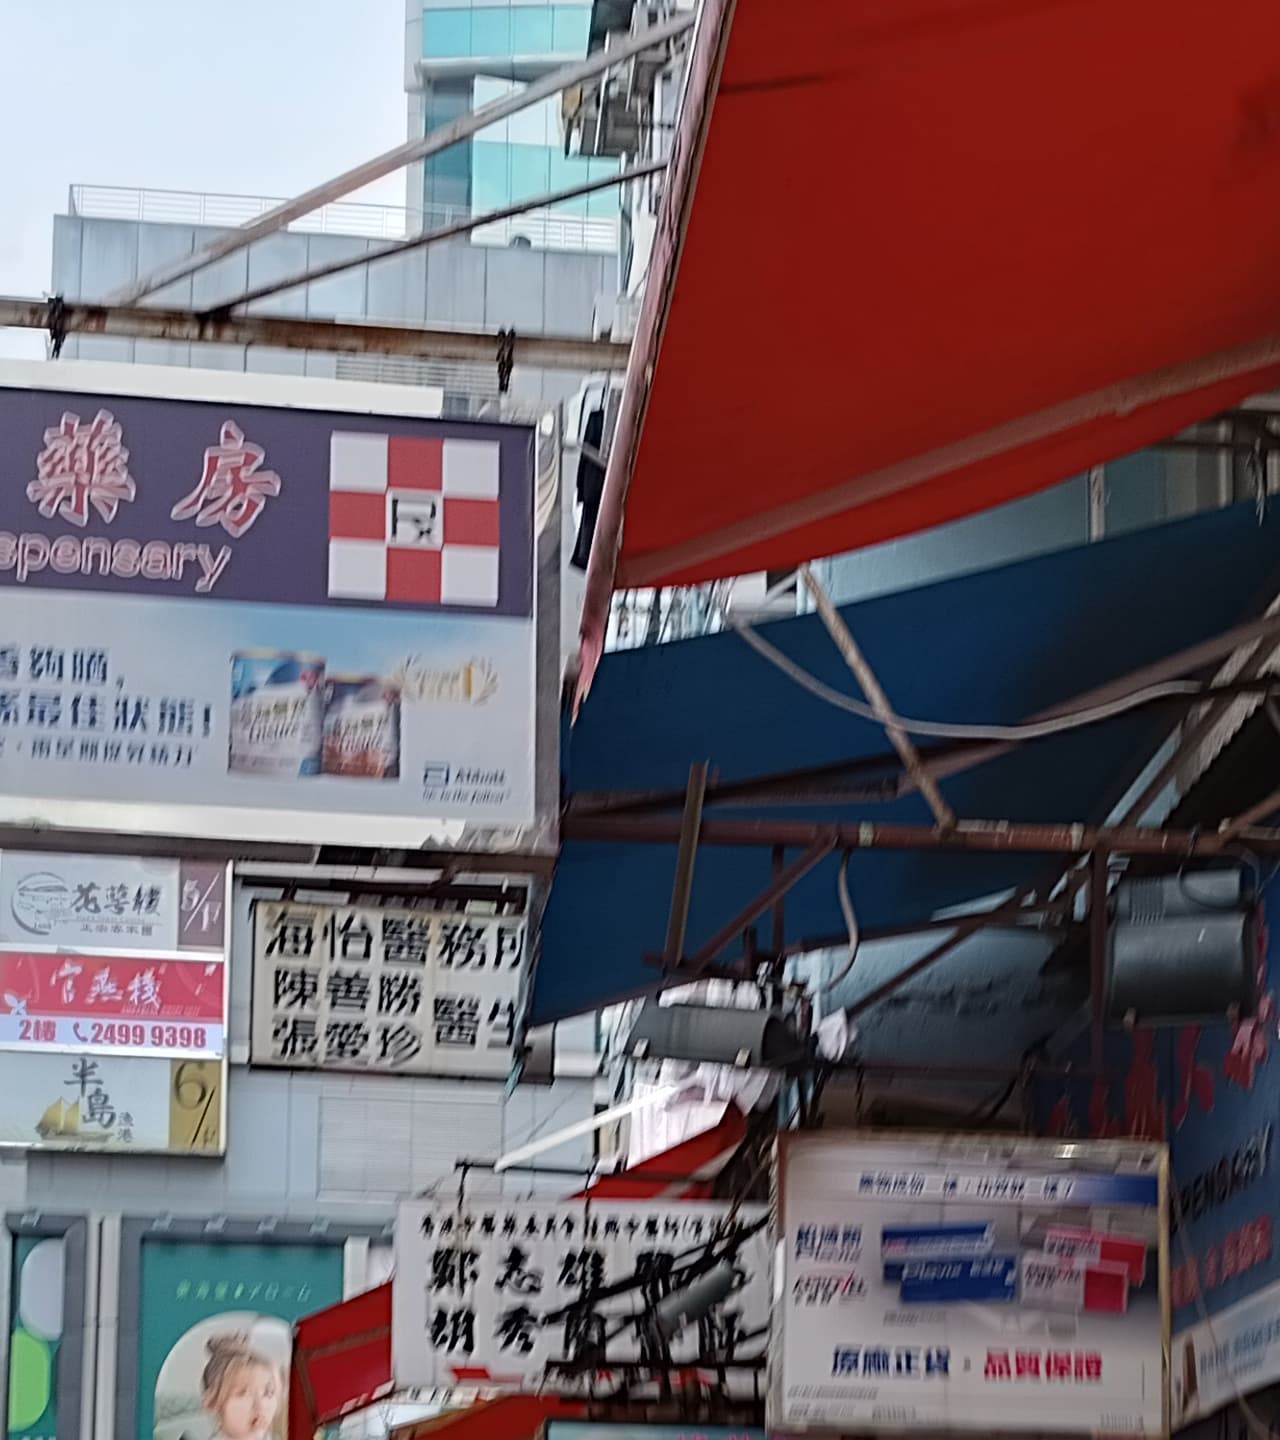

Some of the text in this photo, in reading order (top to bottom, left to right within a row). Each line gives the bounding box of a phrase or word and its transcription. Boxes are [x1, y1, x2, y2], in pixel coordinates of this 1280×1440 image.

[19, 1019, 58, 1042] 2樓
[91, 1022, 207, 1049] 2499 9398
[63, 1056, 117, 1130] 半島
